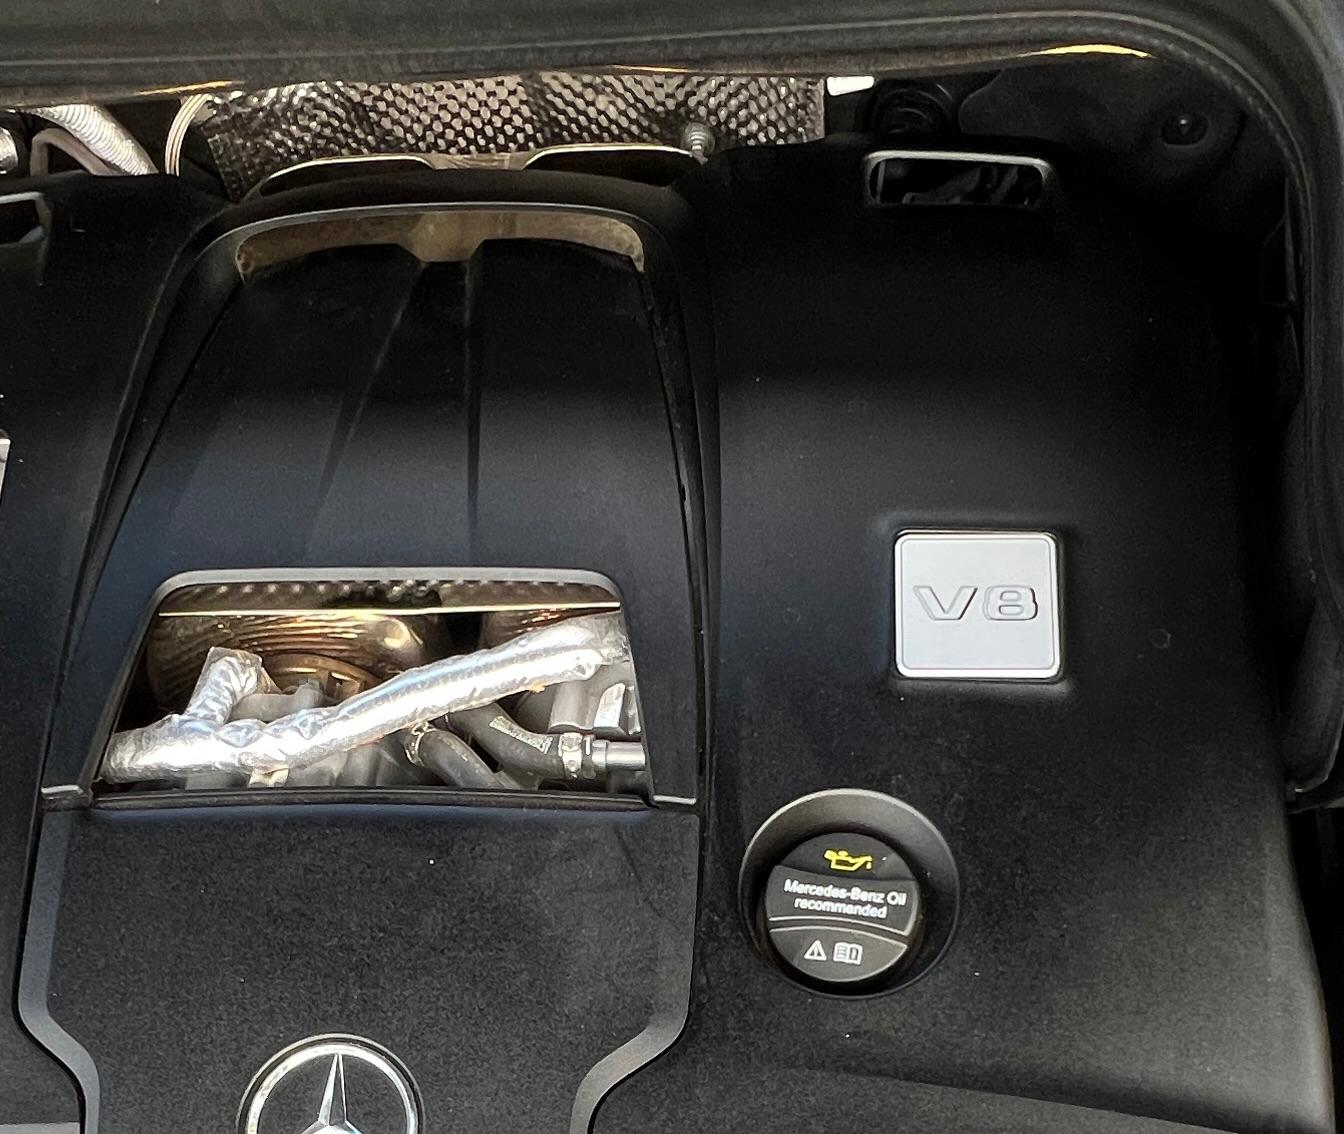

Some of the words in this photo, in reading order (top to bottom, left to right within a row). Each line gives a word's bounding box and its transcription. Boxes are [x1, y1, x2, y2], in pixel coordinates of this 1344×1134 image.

[913, 585, 1038, 621] V8
[784, 878, 885, 904] Mercedes-Benz
[886, 891, 906, 906] Oil
[794, 897, 887, 919] recommended
